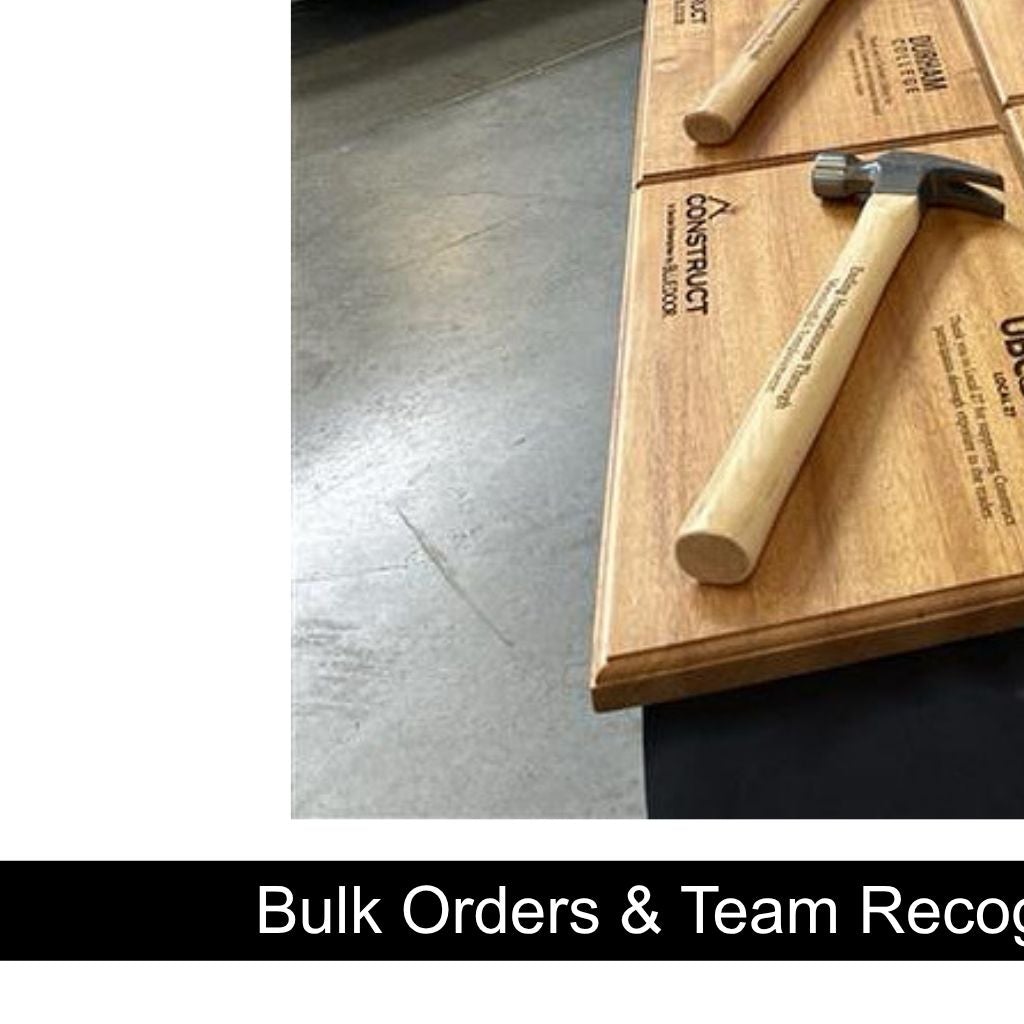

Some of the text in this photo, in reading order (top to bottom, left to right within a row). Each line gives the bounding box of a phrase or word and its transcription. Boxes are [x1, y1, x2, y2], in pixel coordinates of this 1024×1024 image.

[891, 38, 921, 94] COLLEGE
[909, 34, 948, 92] DURHAM
[686, 192, 709, 315] CONSTRUCT
[993, 372, 1010, 405] LOCAL
